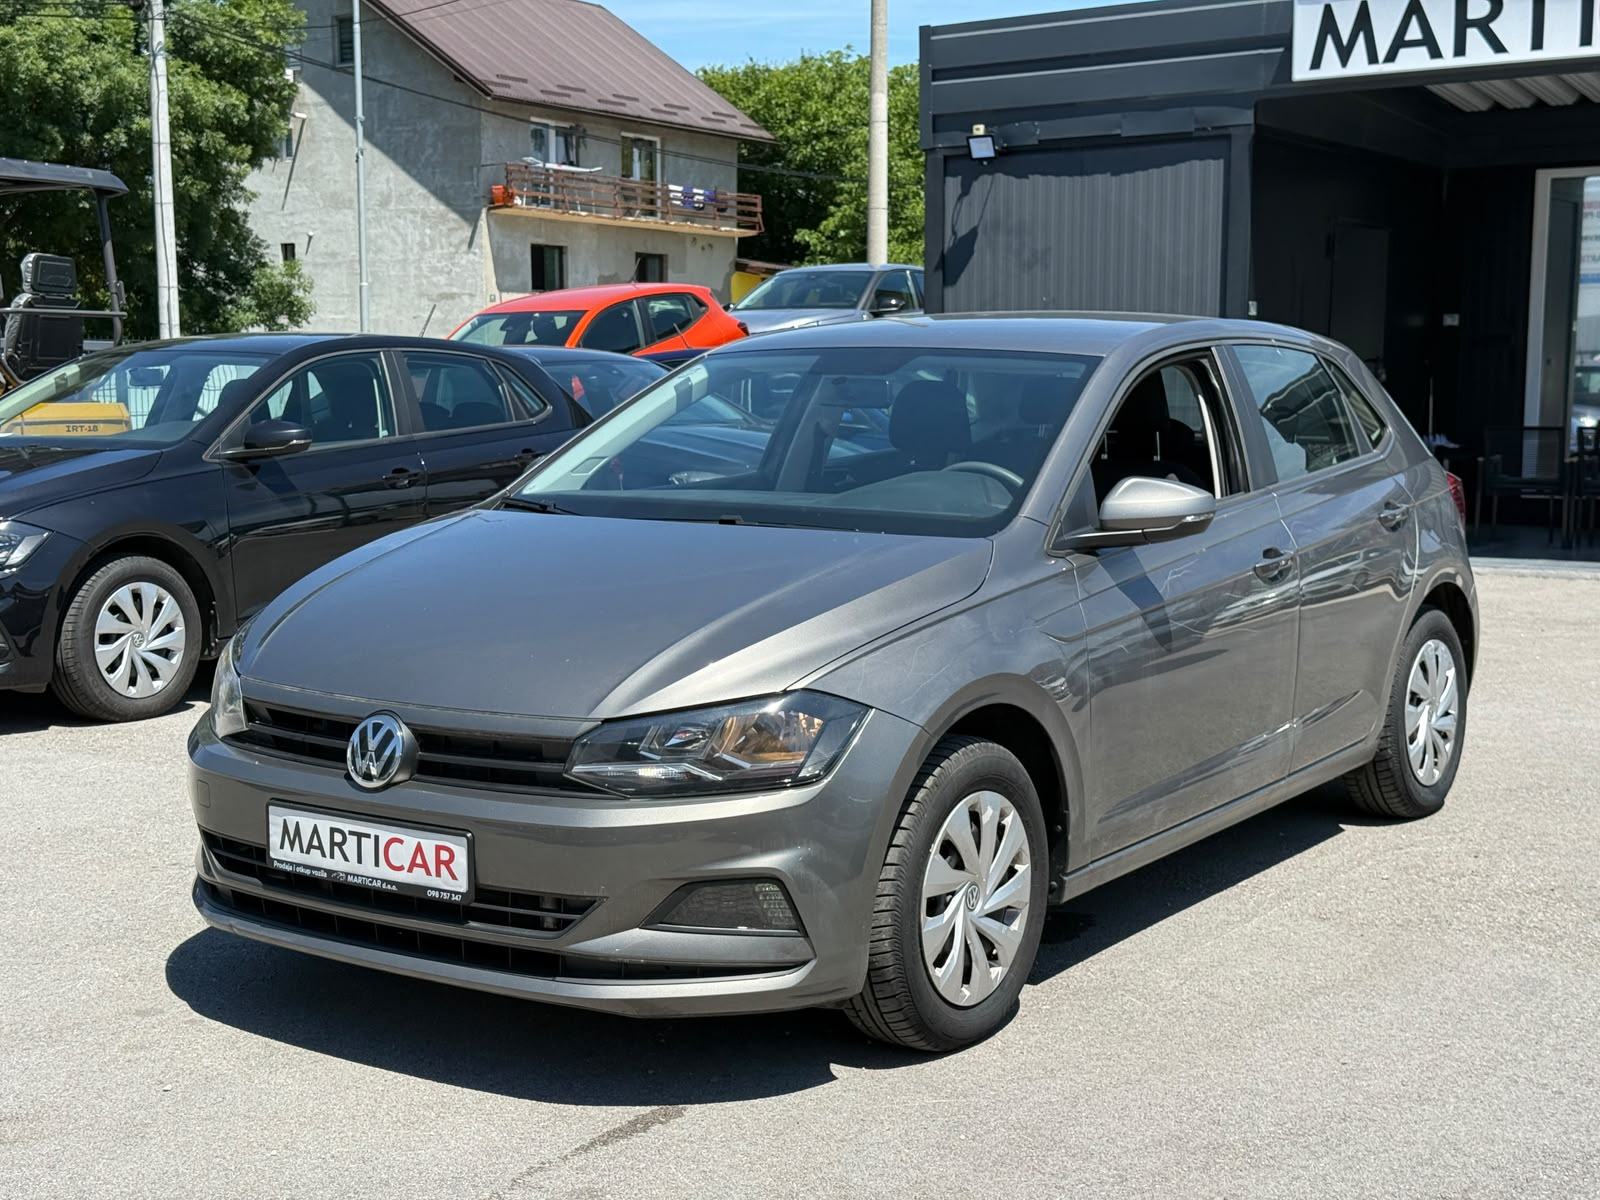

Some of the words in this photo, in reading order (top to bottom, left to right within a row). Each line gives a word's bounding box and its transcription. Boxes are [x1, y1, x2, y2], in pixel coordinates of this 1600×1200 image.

[279, 818, 459, 881] MARTICAR
[347, 875, 381, 888] MARTICAR
[427, 889, 440, 899] 098
[440, 891, 450, 900] 757
[451, 893, 462, 902] 347
